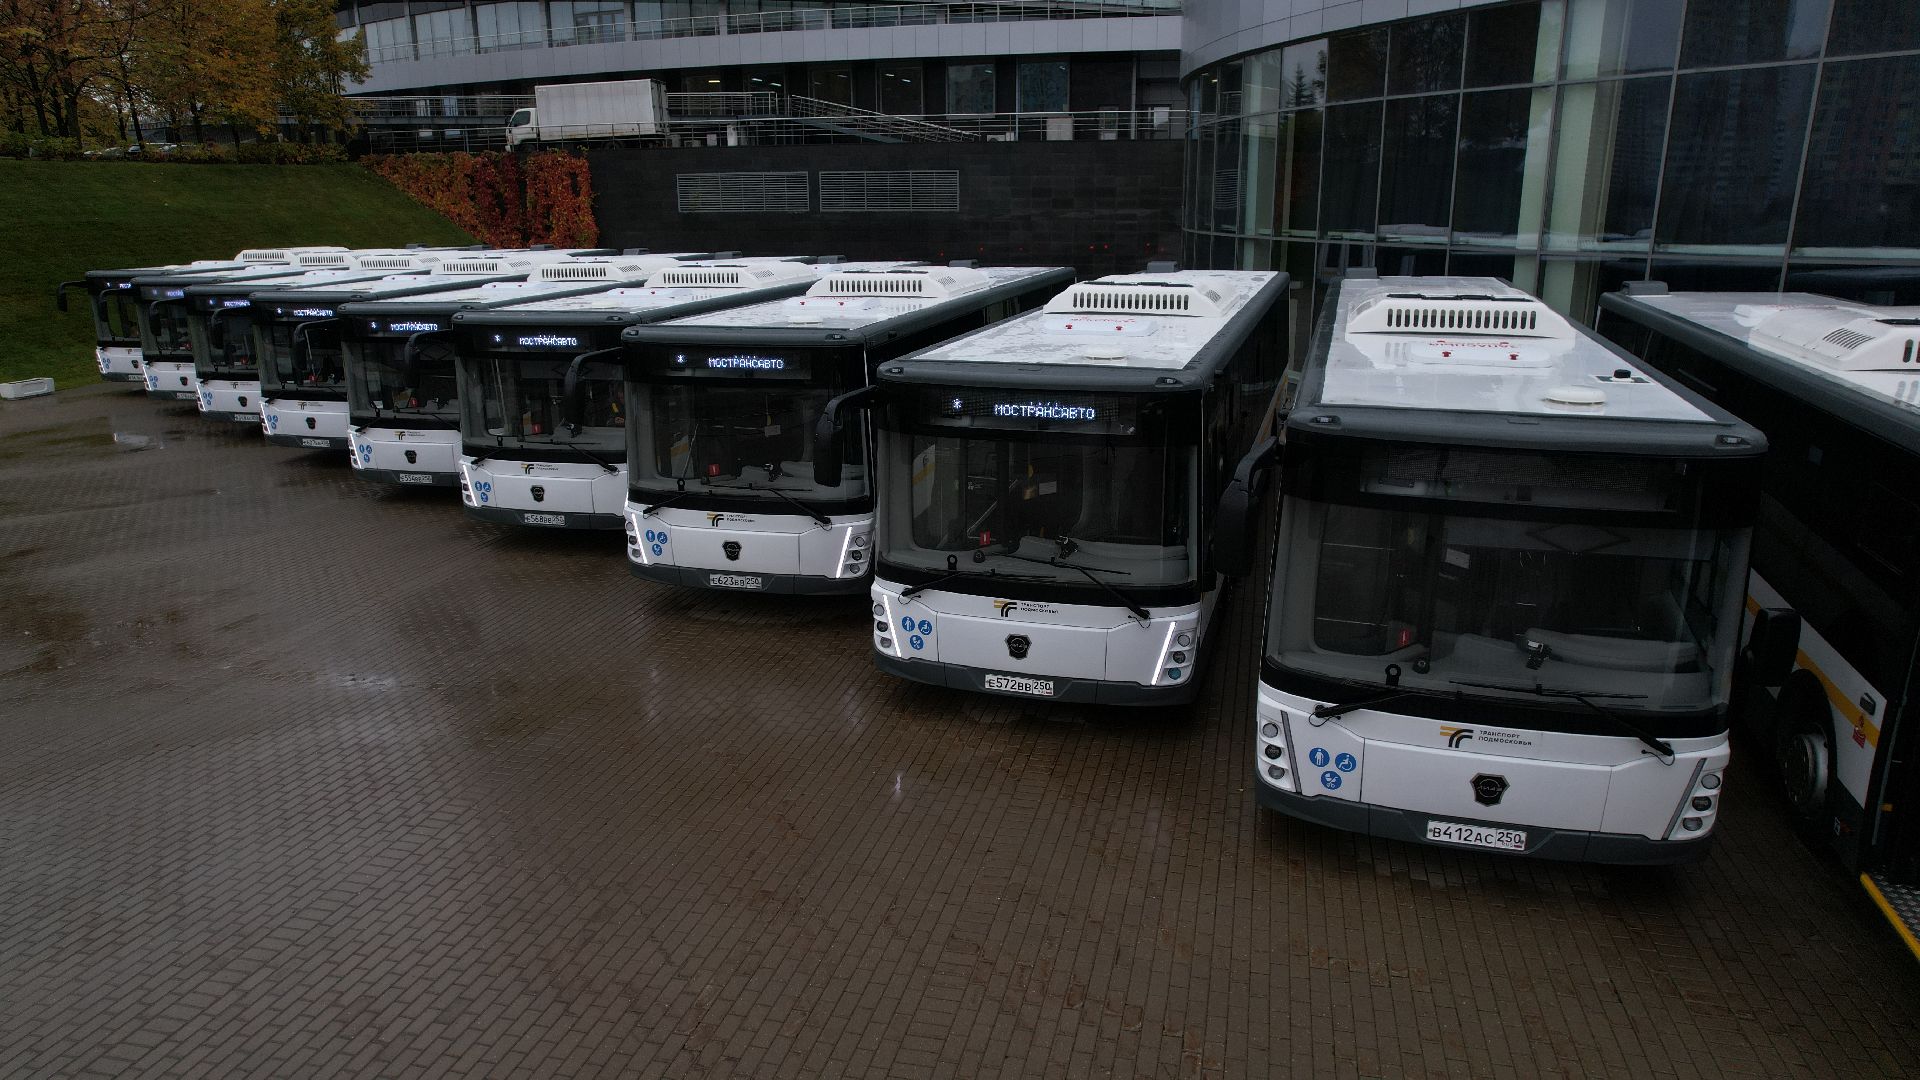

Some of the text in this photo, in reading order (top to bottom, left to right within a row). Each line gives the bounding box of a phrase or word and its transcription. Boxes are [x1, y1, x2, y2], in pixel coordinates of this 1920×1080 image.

[519, 335, 578, 346] МОСТРАНСАВТО
[708, 355, 785, 369] МОСТРАНСАВТО
[994, 402, 1096, 420] МОСТРАНСАВТО
[1033, 681, 1051, 690] 250
[1480, 730, 1520, 739] ТРАНСПОРТ
[1478, 736, 1532, 746] ПОДМОСКОВЬЯ
[1432, 826, 1521, 844] В412АС 250
